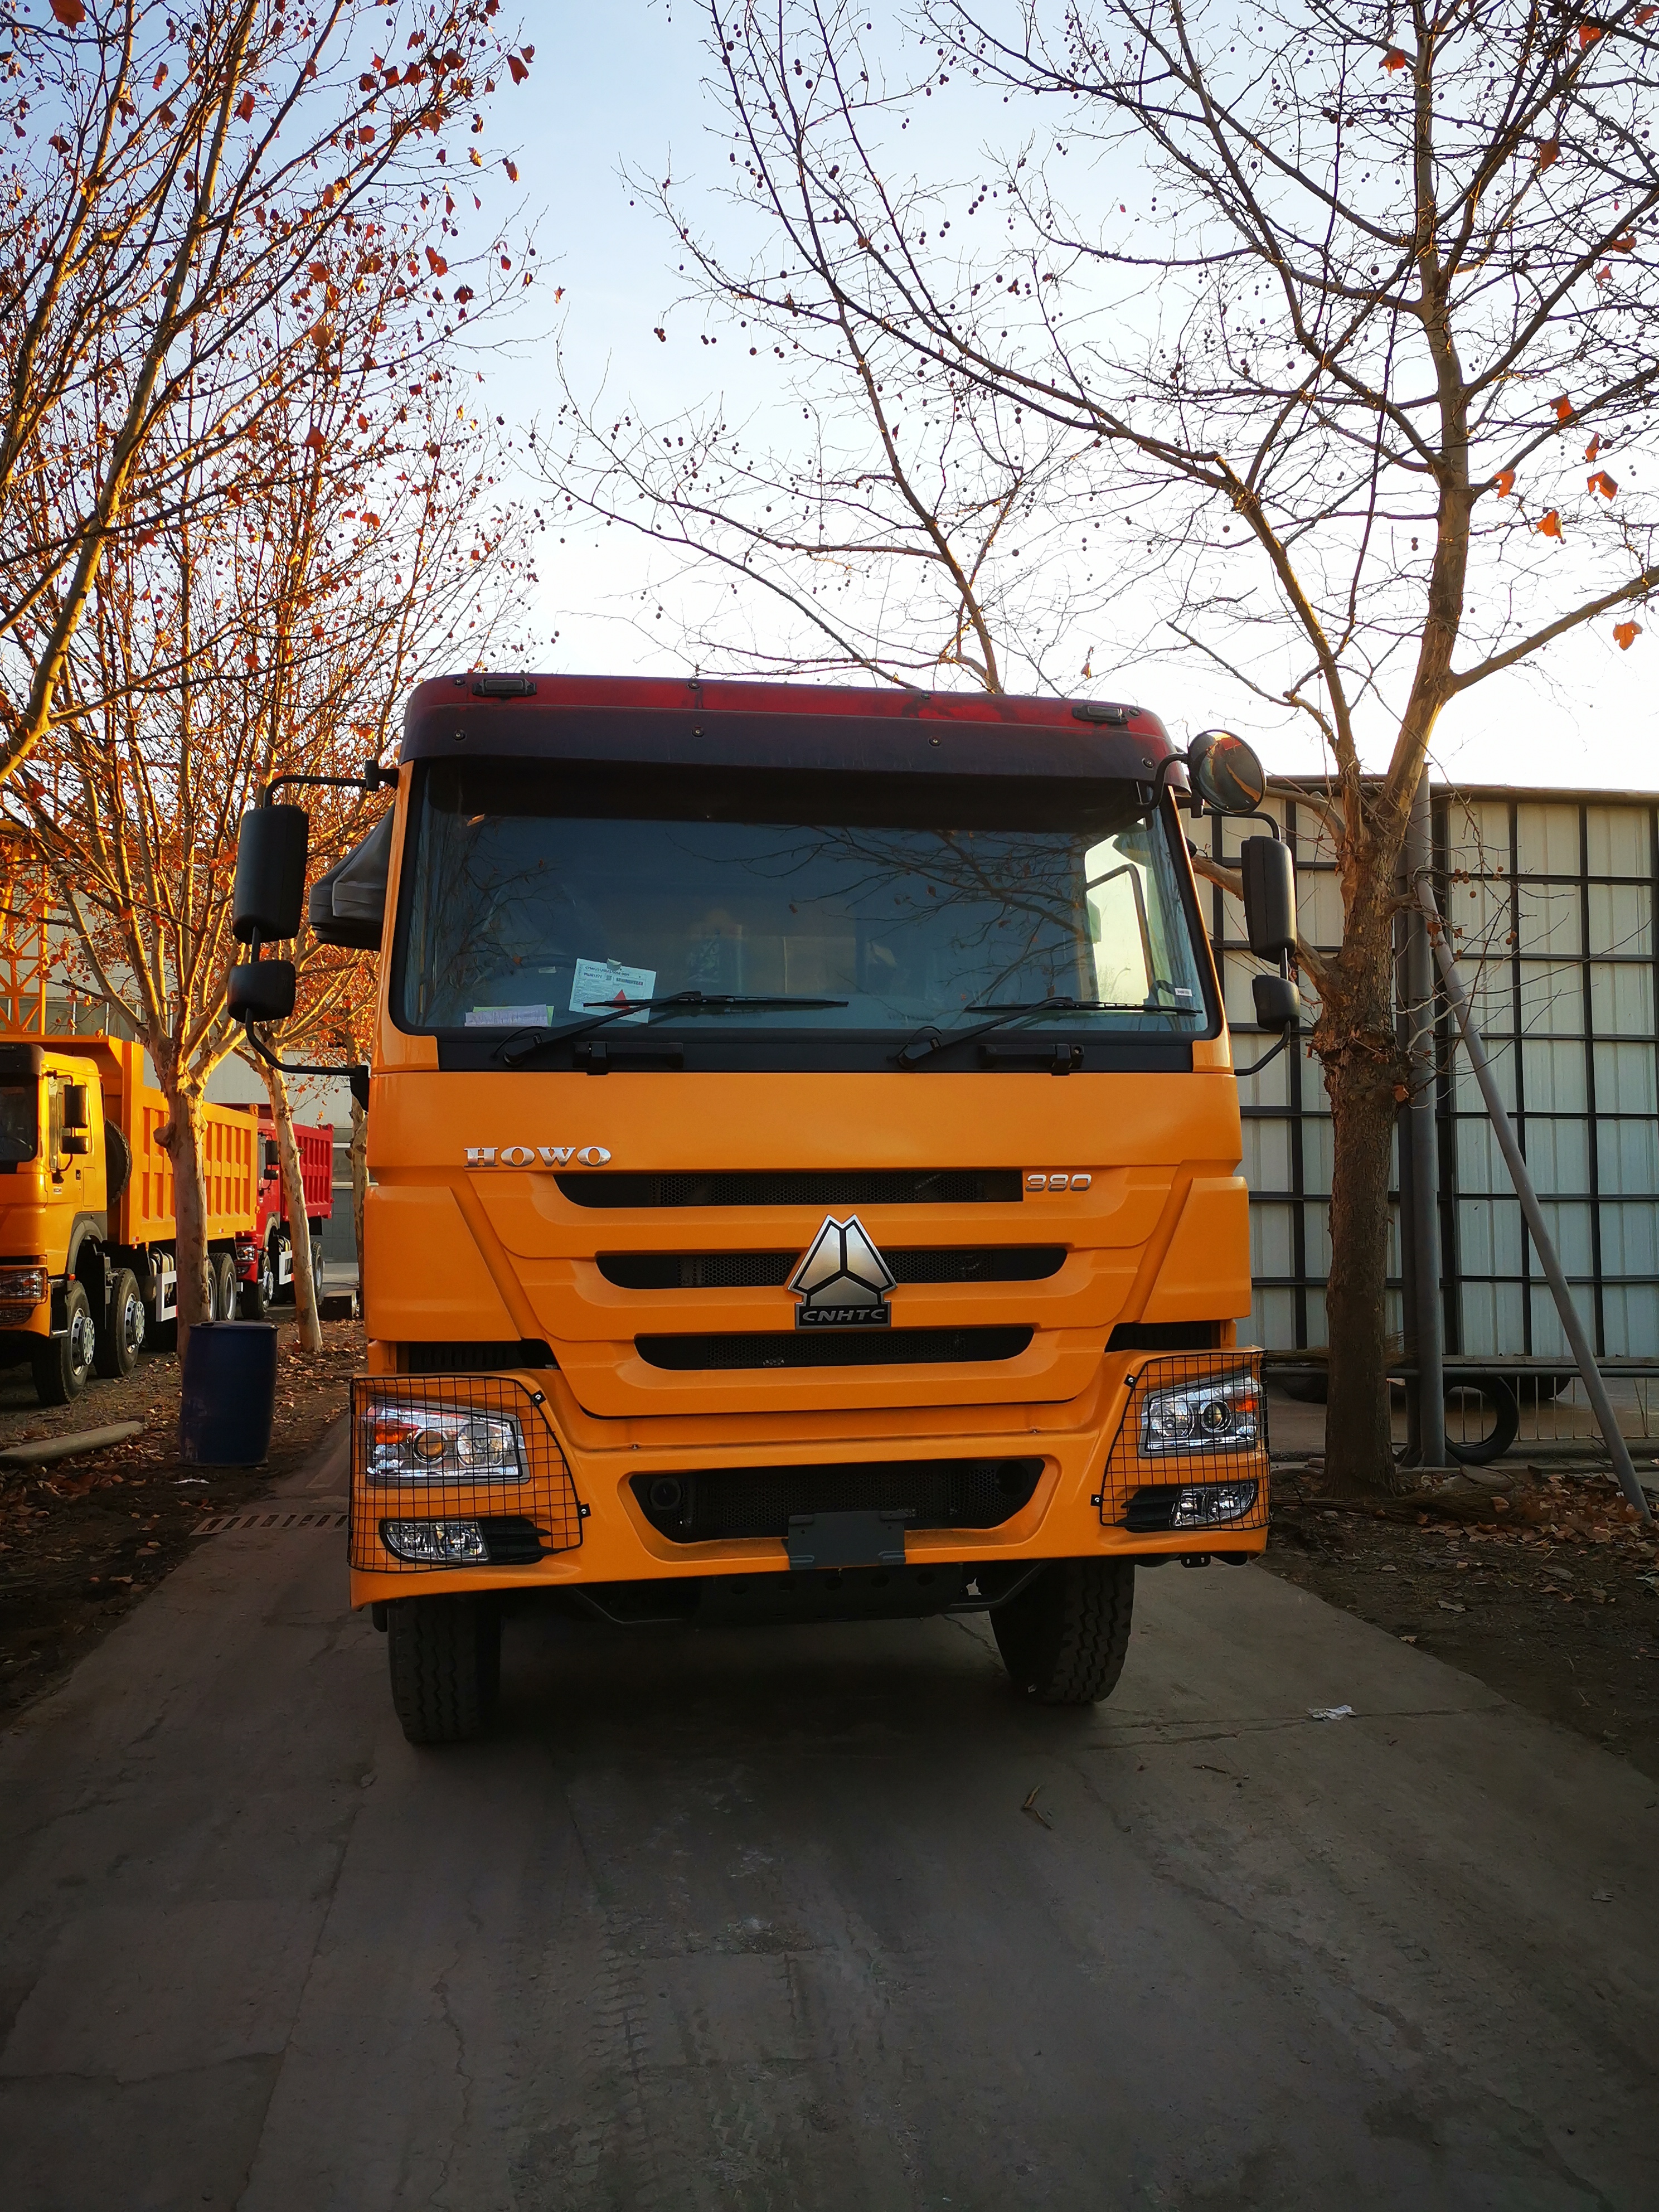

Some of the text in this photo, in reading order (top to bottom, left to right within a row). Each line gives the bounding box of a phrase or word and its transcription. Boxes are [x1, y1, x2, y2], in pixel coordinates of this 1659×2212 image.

[464, 1146, 612, 1167] HOWO
[1026, 1174, 1092, 1192] 380
[803, 1309, 885, 1321] CNHTC
